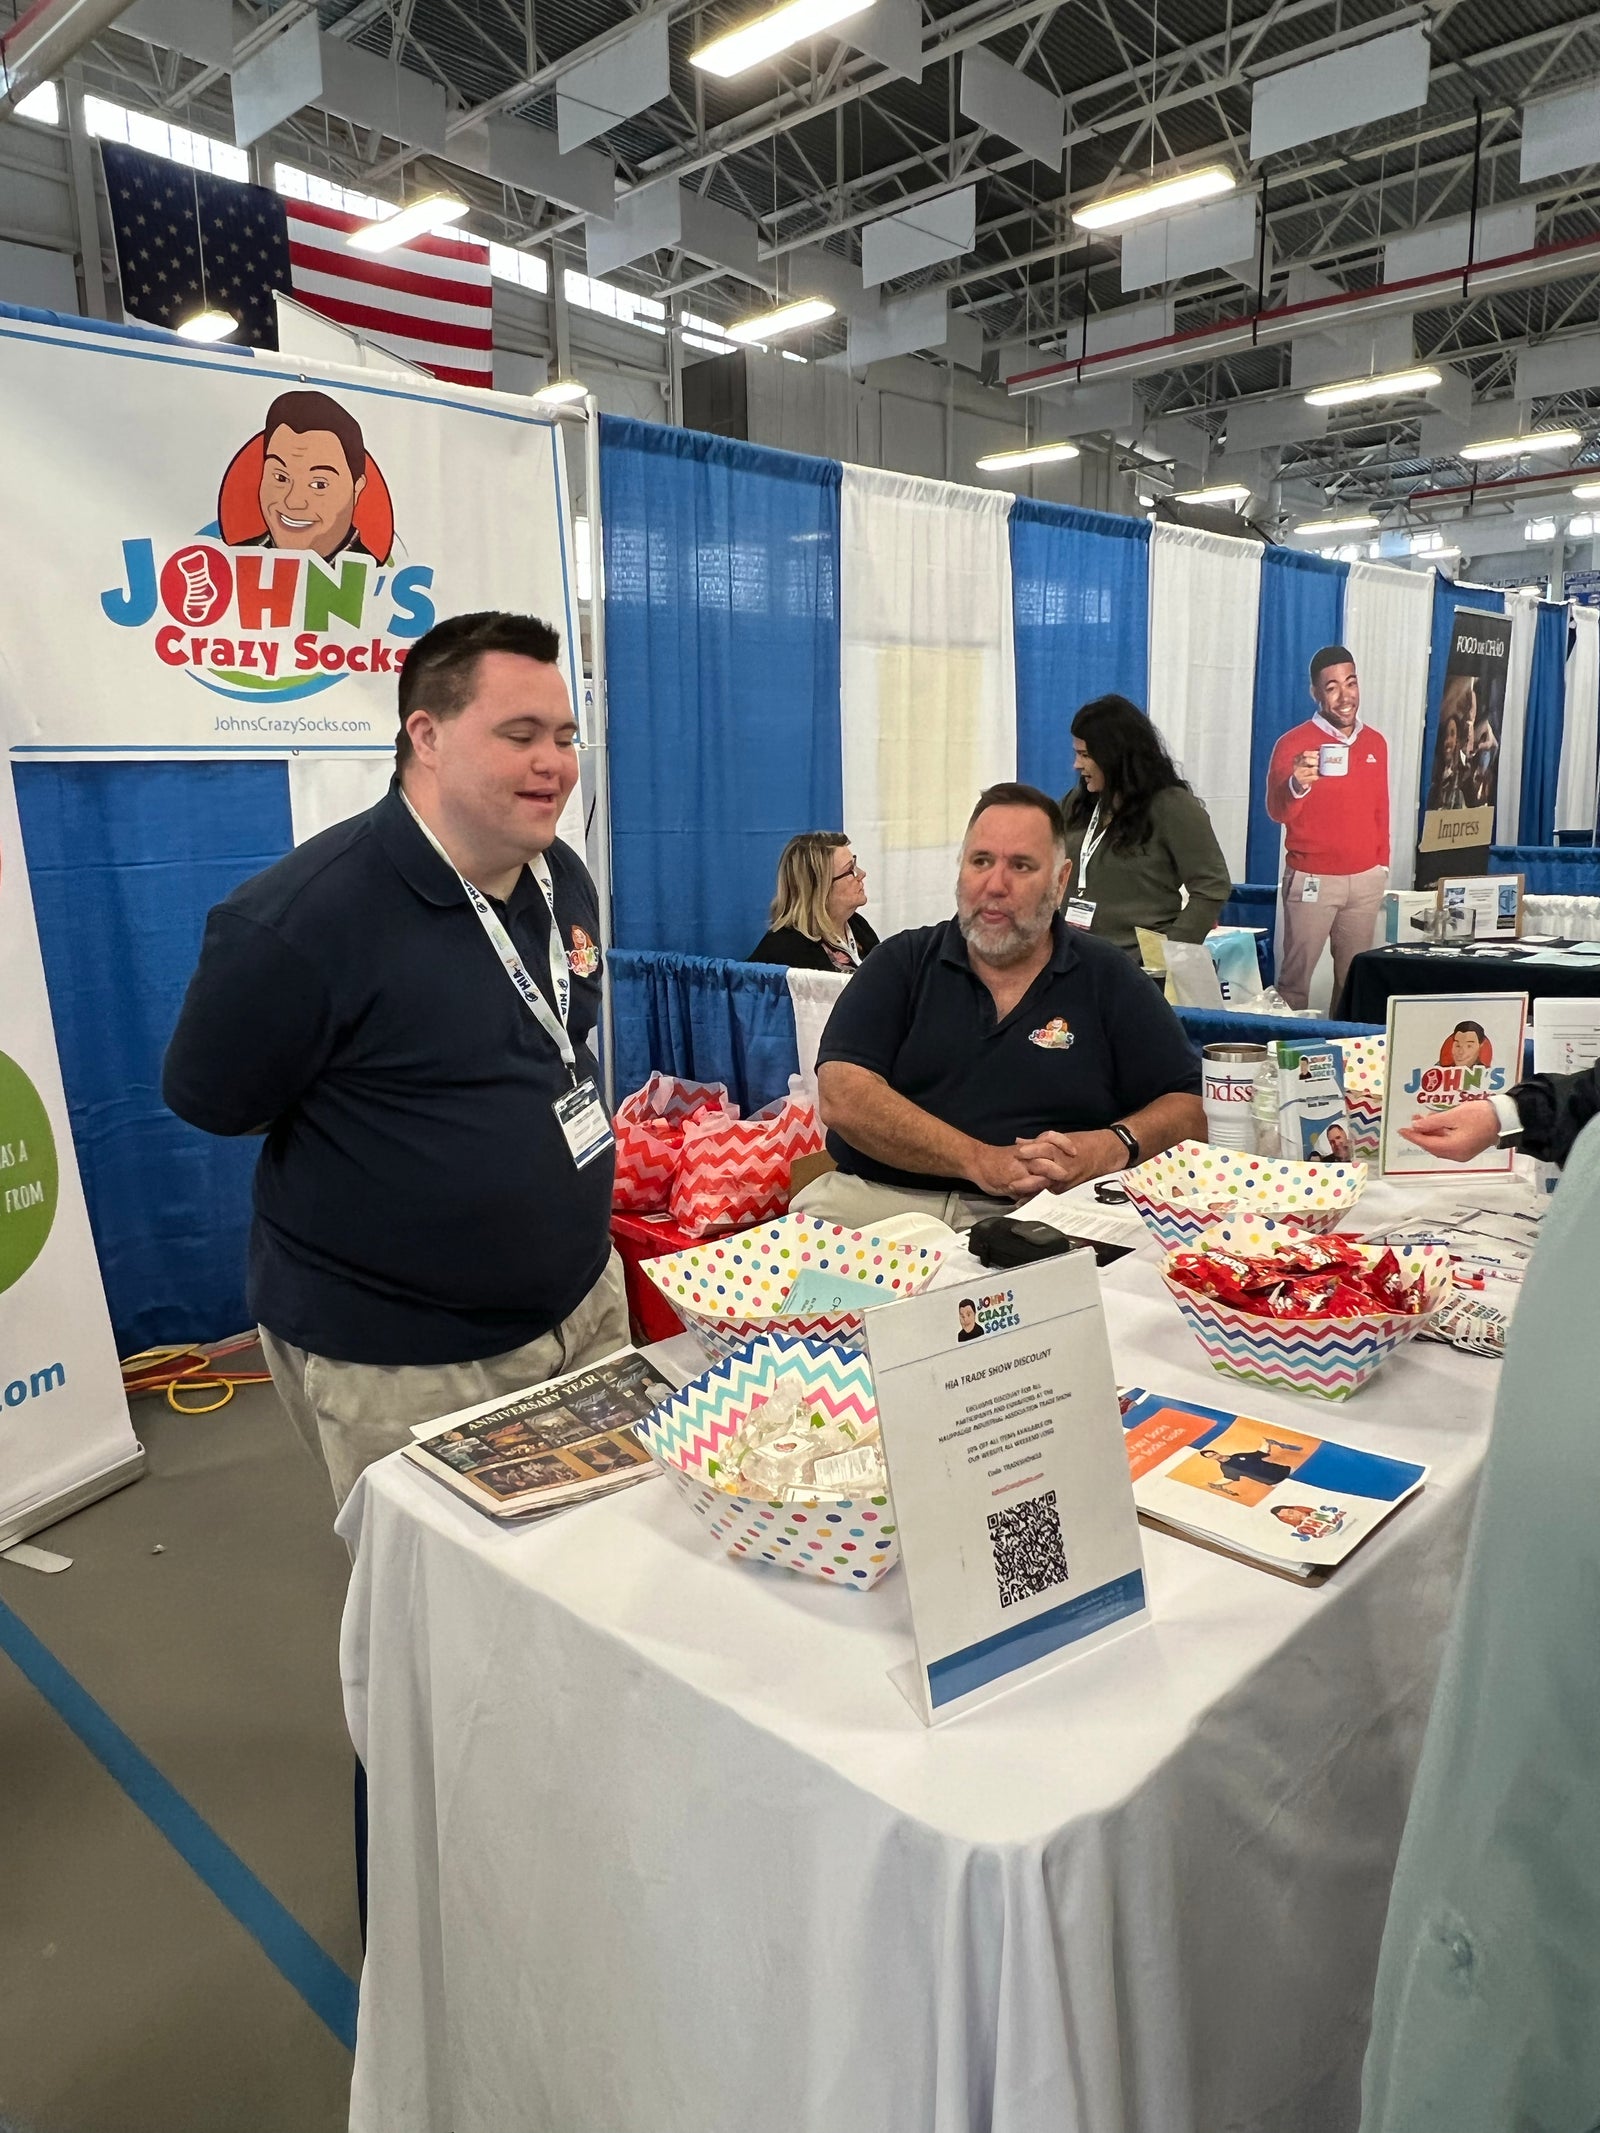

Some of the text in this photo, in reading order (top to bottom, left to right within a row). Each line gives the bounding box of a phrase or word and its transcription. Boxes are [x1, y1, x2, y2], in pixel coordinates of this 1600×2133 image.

[101, 537, 435, 638] JOHN'S
[154, 625, 279, 676] Crazy
[214, 716, 371, 734] JohnsCrazySocks.com
[1437, 817, 1480, 844] Impress
[1404, 1068, 1505, 1094] JOHN'S
[1417, 1091, 1455, 1105] Crazy
[19, 1139, 28, 1162] A
[5, 1181, 44, 1213] FROM
[978, 1304, 1014, 1323] CRAZY
[985, 1313, 1020, 1334] SOCKS
[945, 1348, 1052, 1391] HIA TRADE SHOW DISCOUNT
[468, 1392, 561, 1431] ANNIVERSARY
[563, 1373, 600, 1396] YEAR
